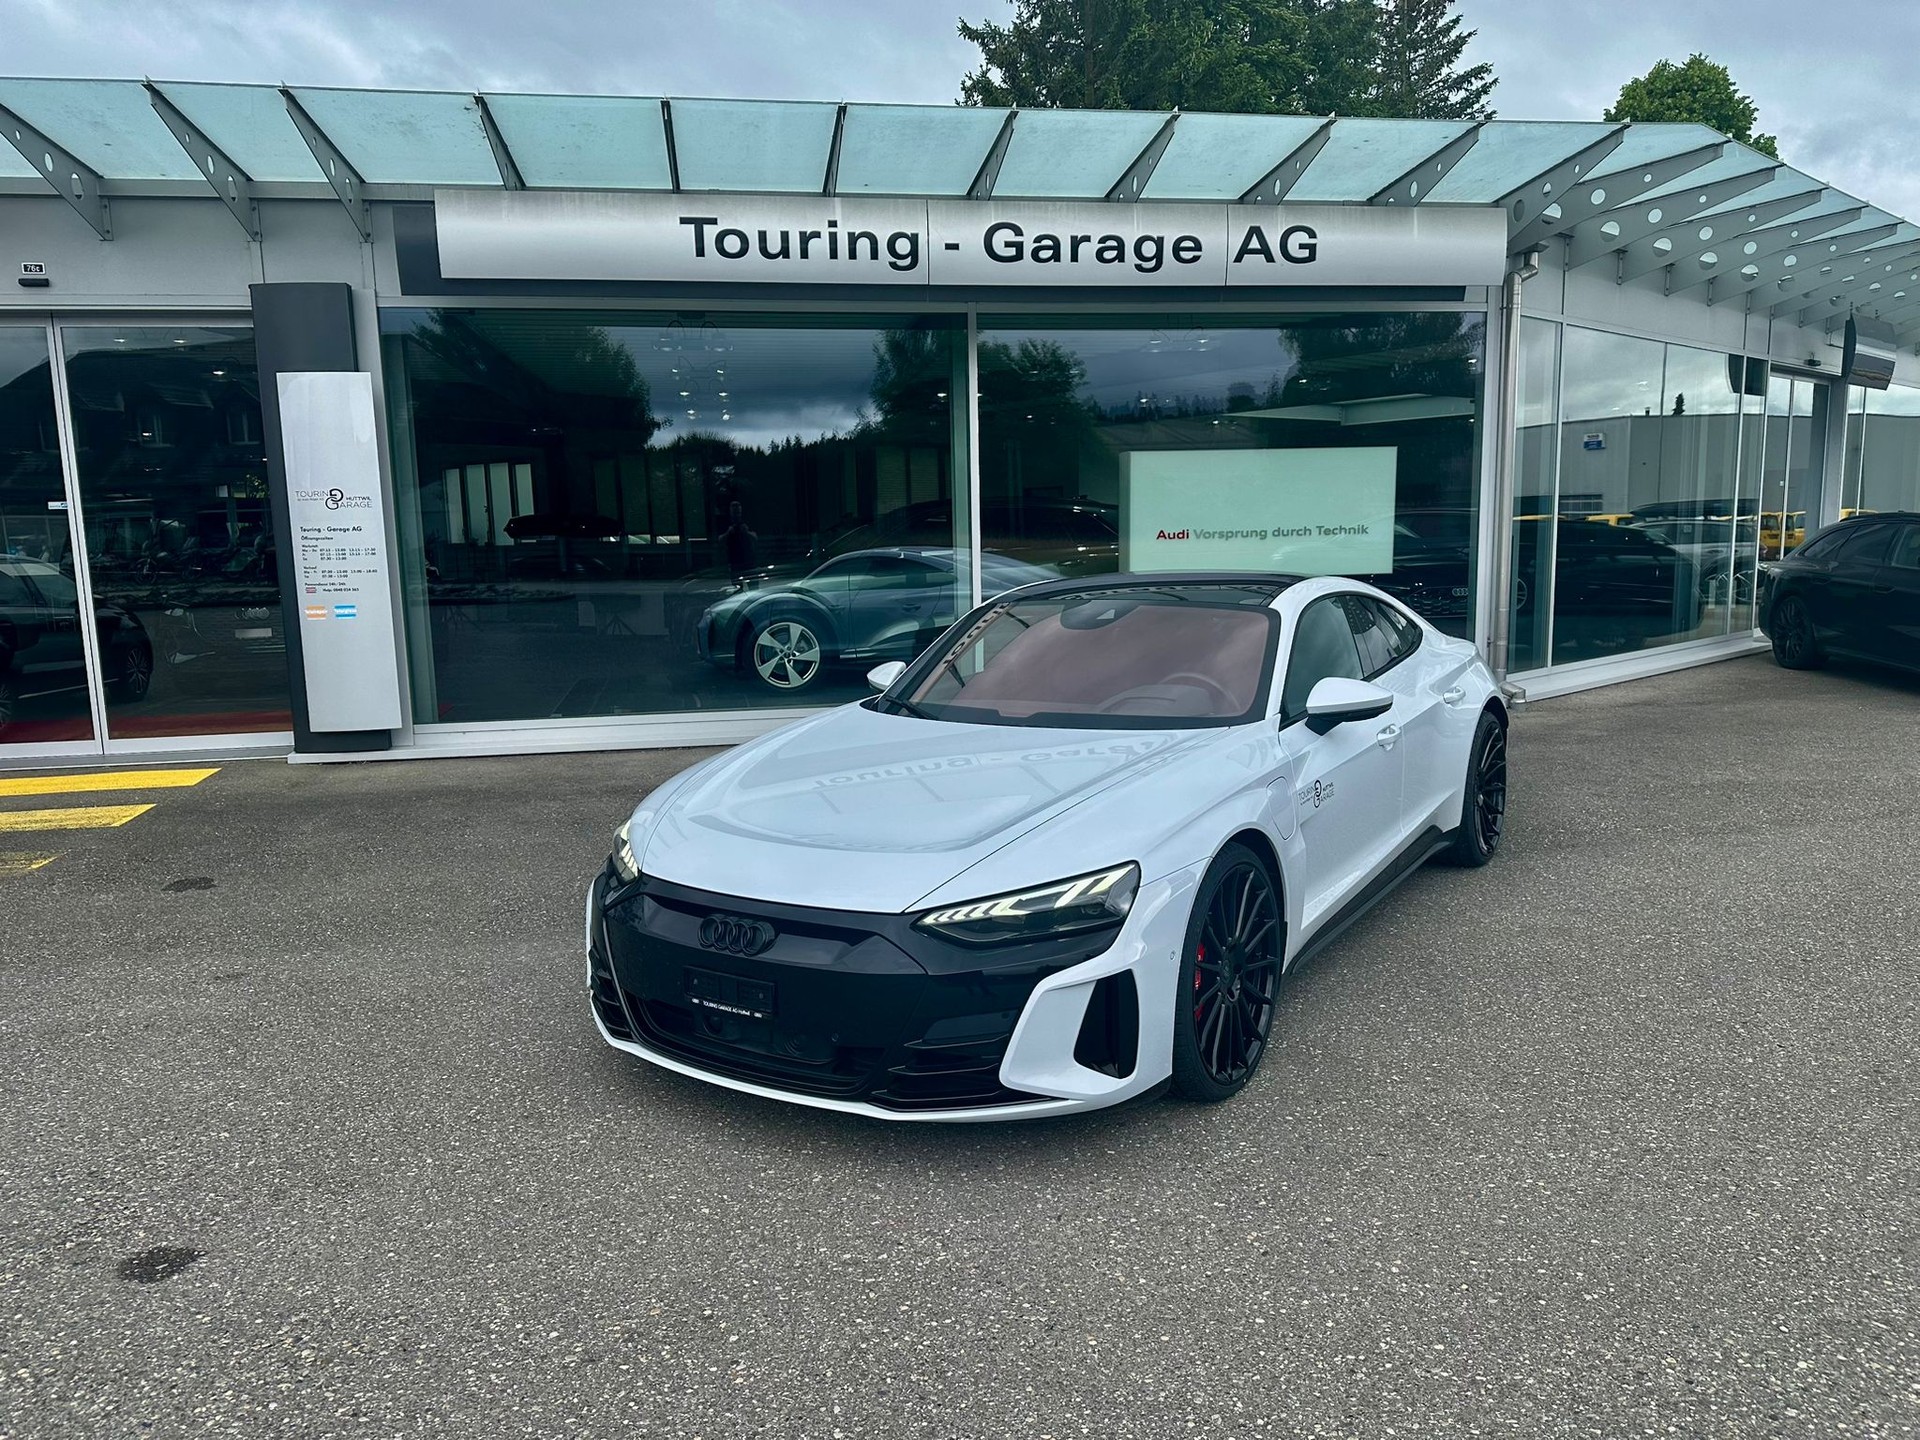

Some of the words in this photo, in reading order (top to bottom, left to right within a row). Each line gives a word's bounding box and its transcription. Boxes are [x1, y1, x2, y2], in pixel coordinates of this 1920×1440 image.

[679, 216, 920, 271] Touring
[982, 220, 1203, 274] Garage
[1233, 224, 1318, 264] AG
[327, 525, 350, 533] Garage
[1156, 529, 1190, 541] Audi
[1193, 528, 1267, 541] Vorsprung
[1272, 525, 1312, 538] durch
[1316, 524, 1369, 536] Technik
